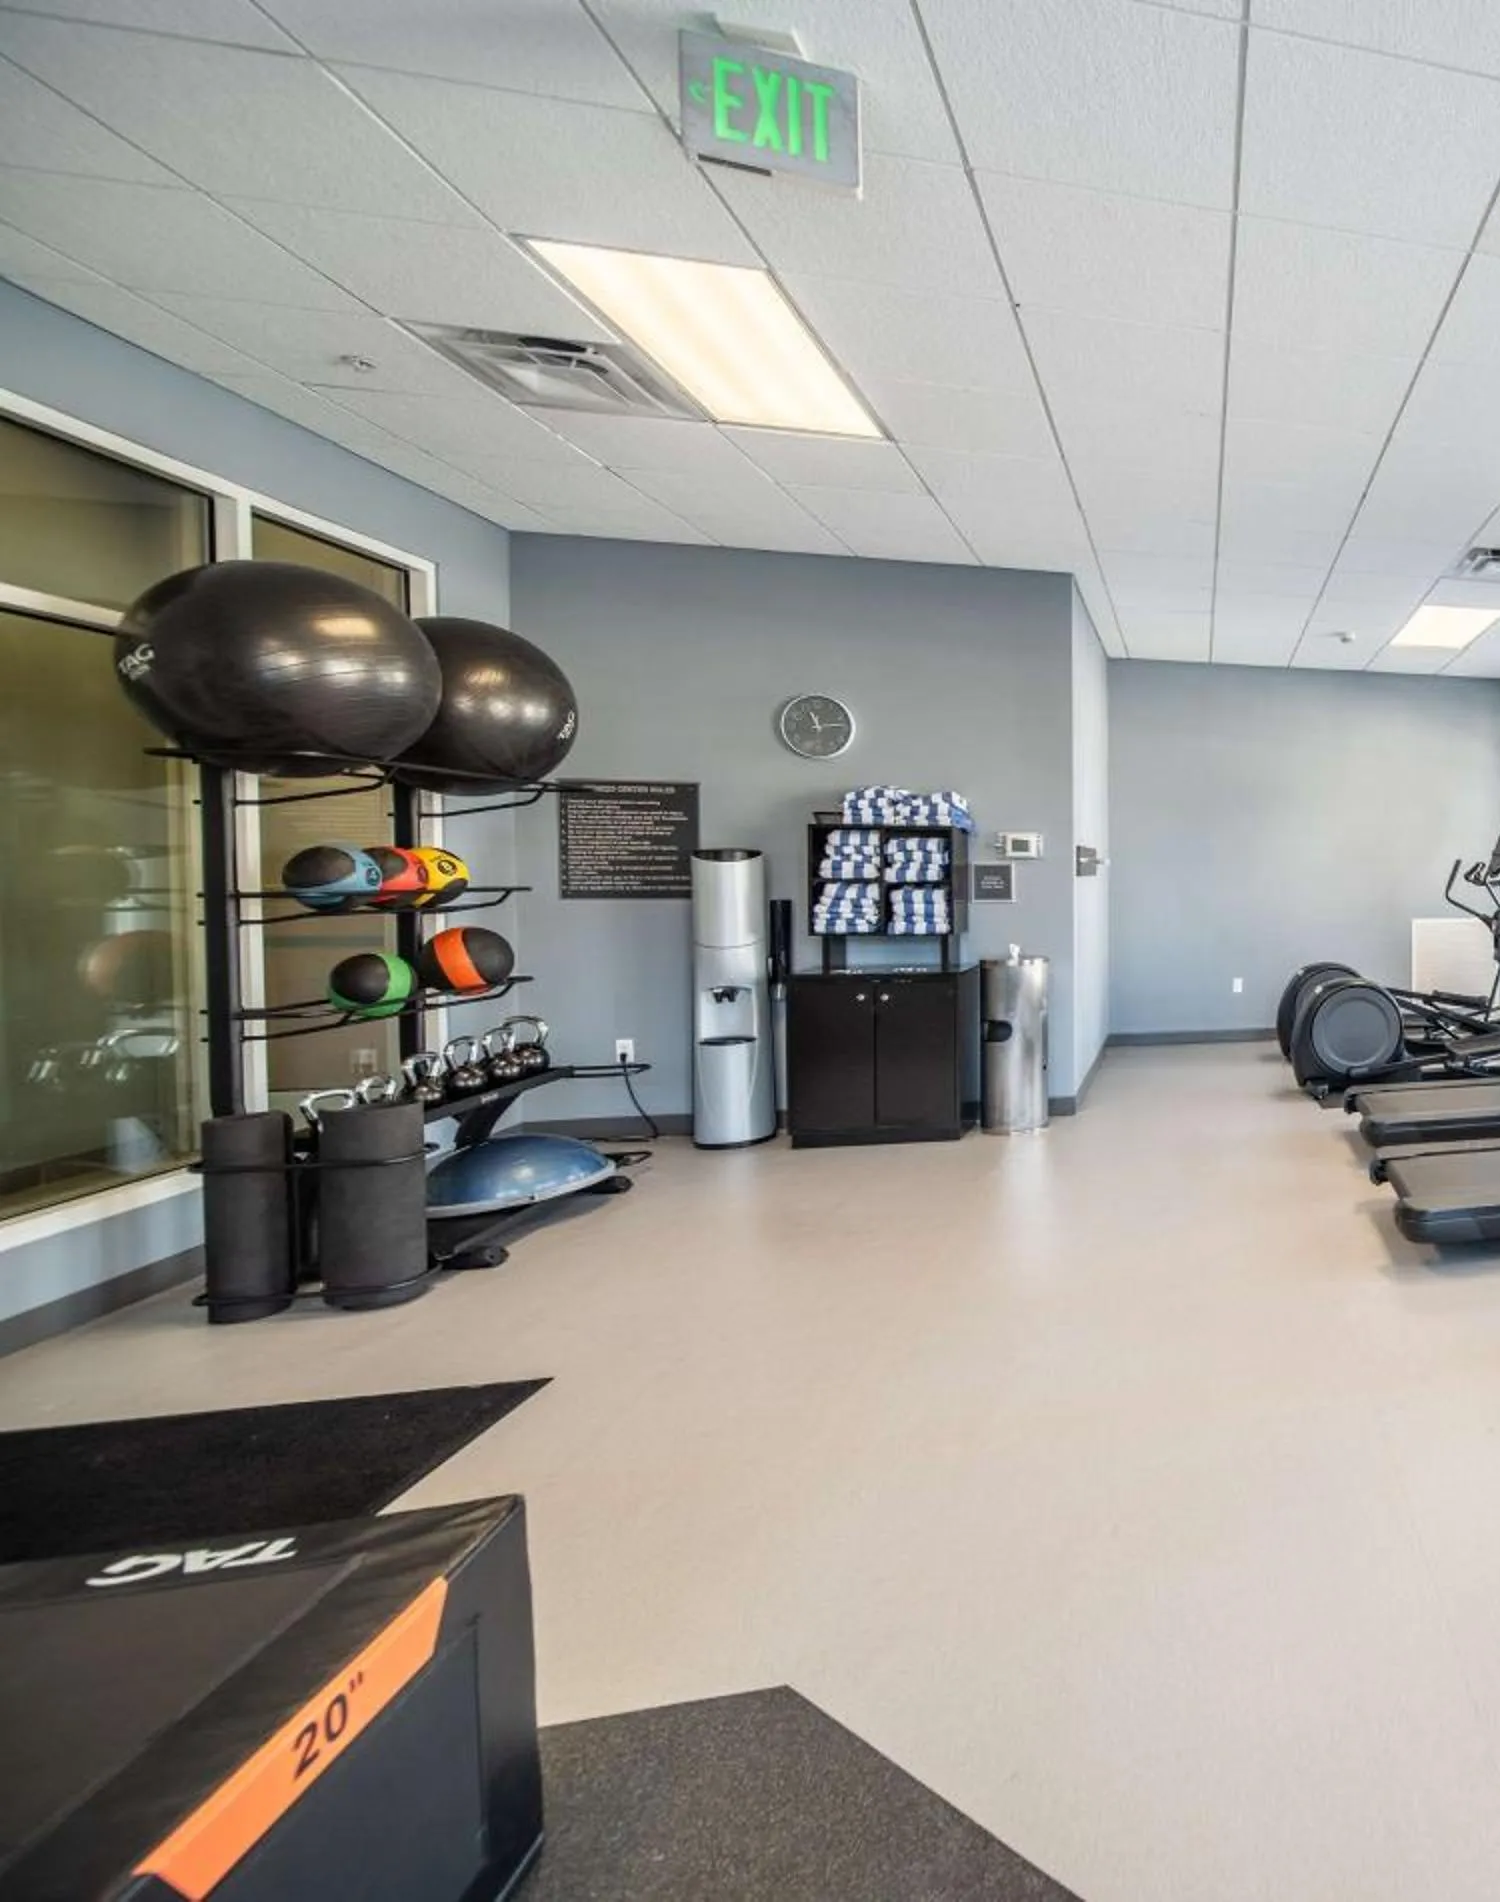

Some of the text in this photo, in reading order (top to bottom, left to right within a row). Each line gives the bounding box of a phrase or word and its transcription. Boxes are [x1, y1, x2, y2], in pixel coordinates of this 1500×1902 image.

[712, 56, 835, 163] EXIT
[119, 643, 155, 674] TAG
[85, 1537, 298, 1586] TAG
[291, 1671, 364, 1781] 20"
